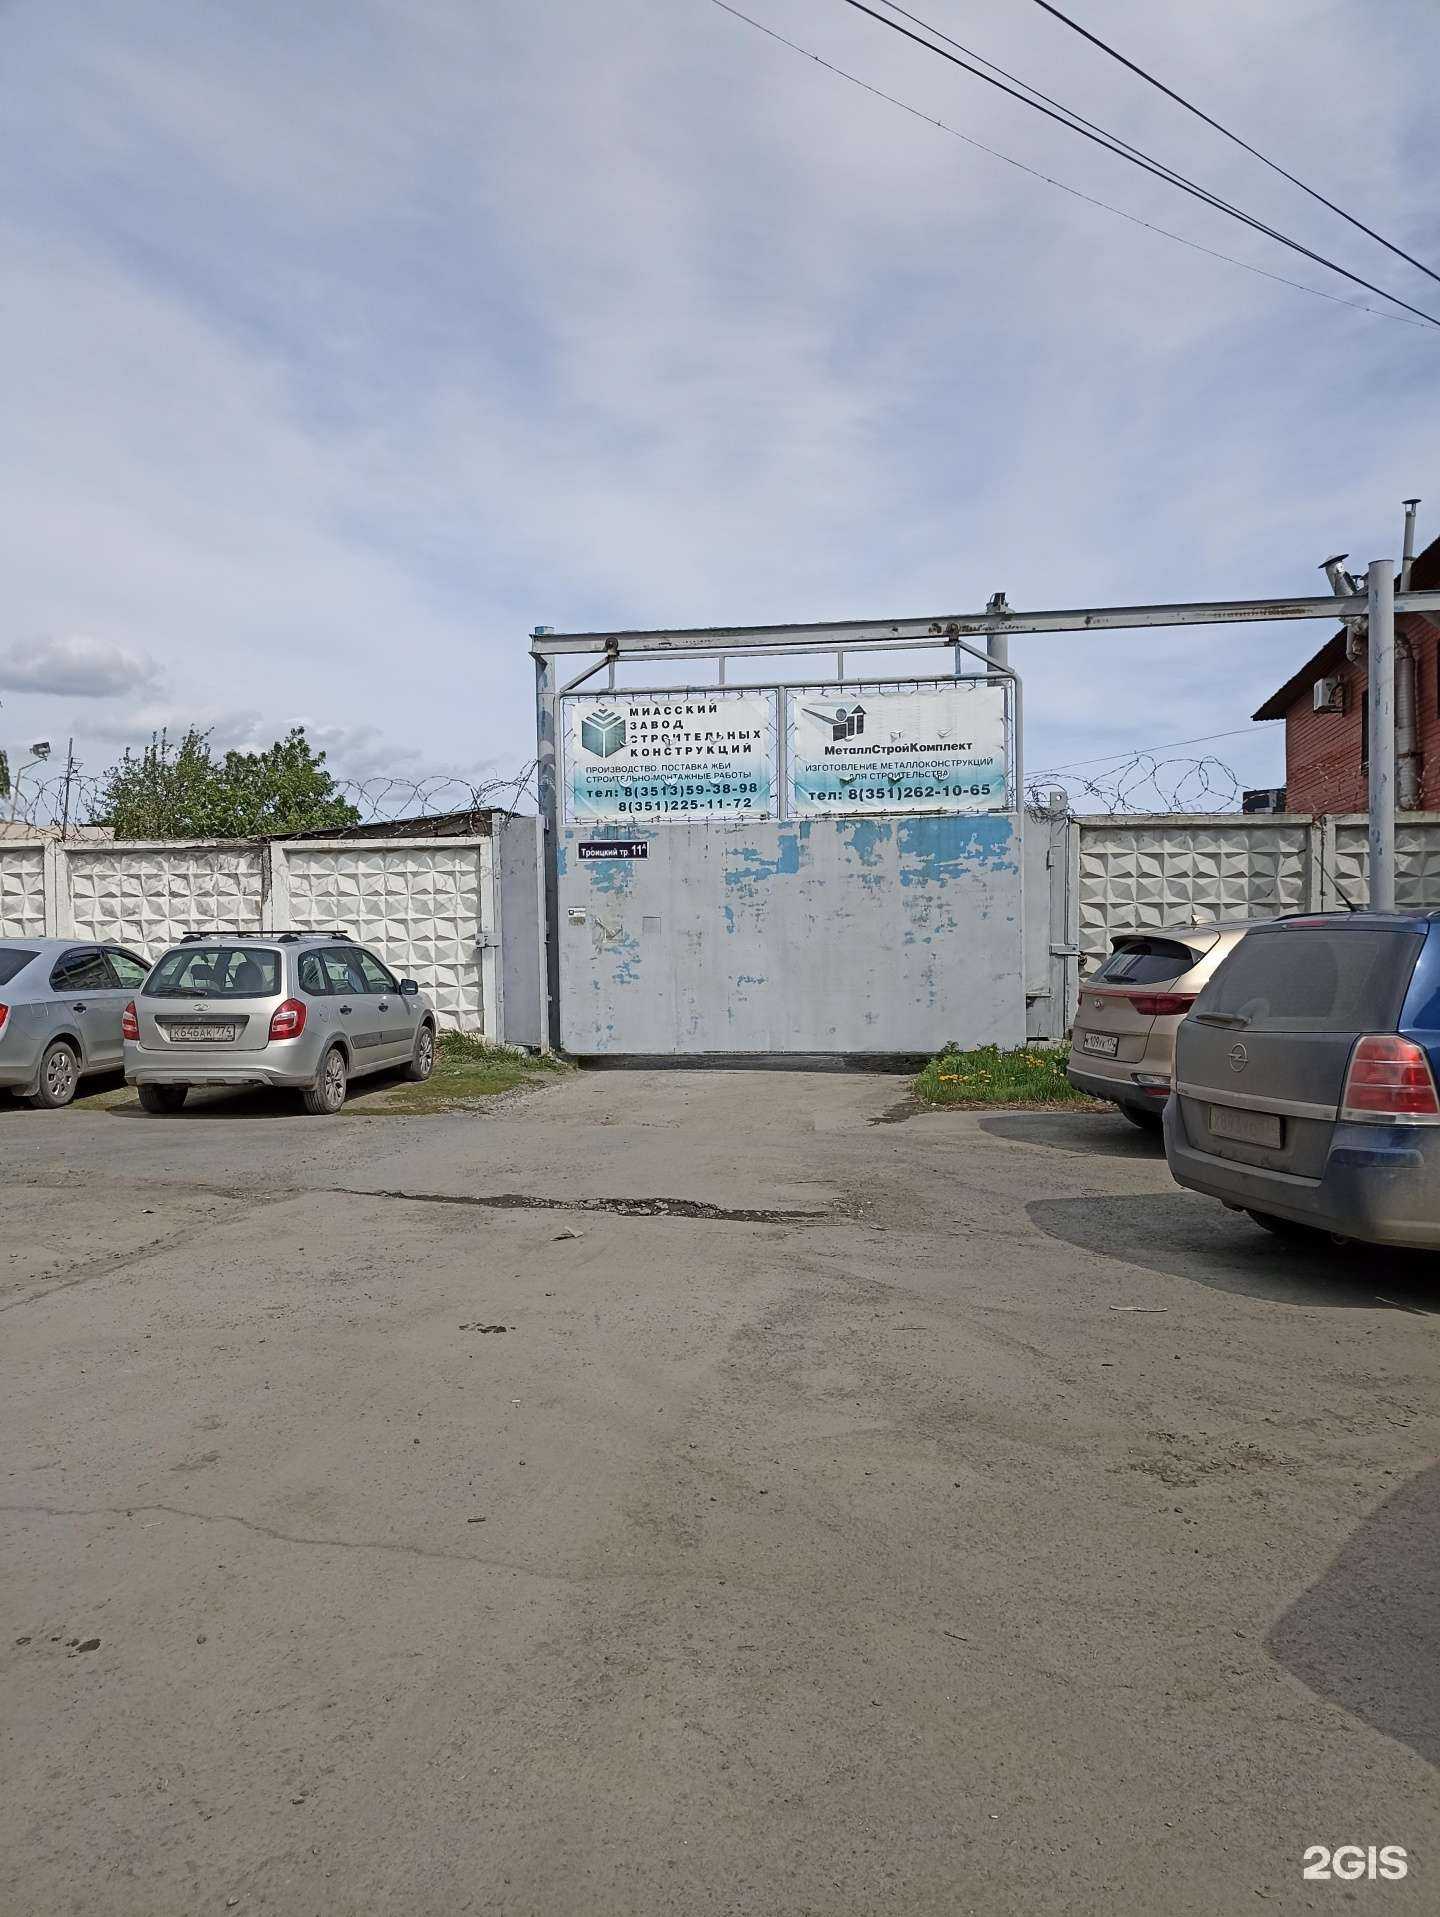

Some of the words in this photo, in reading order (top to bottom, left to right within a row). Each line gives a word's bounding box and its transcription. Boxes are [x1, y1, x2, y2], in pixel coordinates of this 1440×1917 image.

[629, 703, 717, 716] МИАССКИЙ
[630, 720, 684, 730] ЗАВОД
[630, 743, 752, 757] КОНСТРУКЦИЙ
[824, 743, 973, 755] МеталлСтройКомплект
[586, 765, 657, 774] ПРОИЗВОДСТВО
[661, 763, 708, 771] ПОСТАВКА
[711, 762, 731, 770] ЖБИ
[805, 762, 878, 772] ИЗГОТОВЛЕНИЕ
[880, 757, 993, 770] МЕТАЛЛОКОНСТРУКЦИЙ
[714, 771, 752, 779] РАБОТЫ
[624, 783, 758, 798] 8(3513)59-38-98
[808, 791, 843, 801] тел:
[849, 784, 991, 801] 8(351)262-10-65
[618, 798, 752, 813] 8(351)225-11-72
[581, 847, 618, 858] Троицкий
